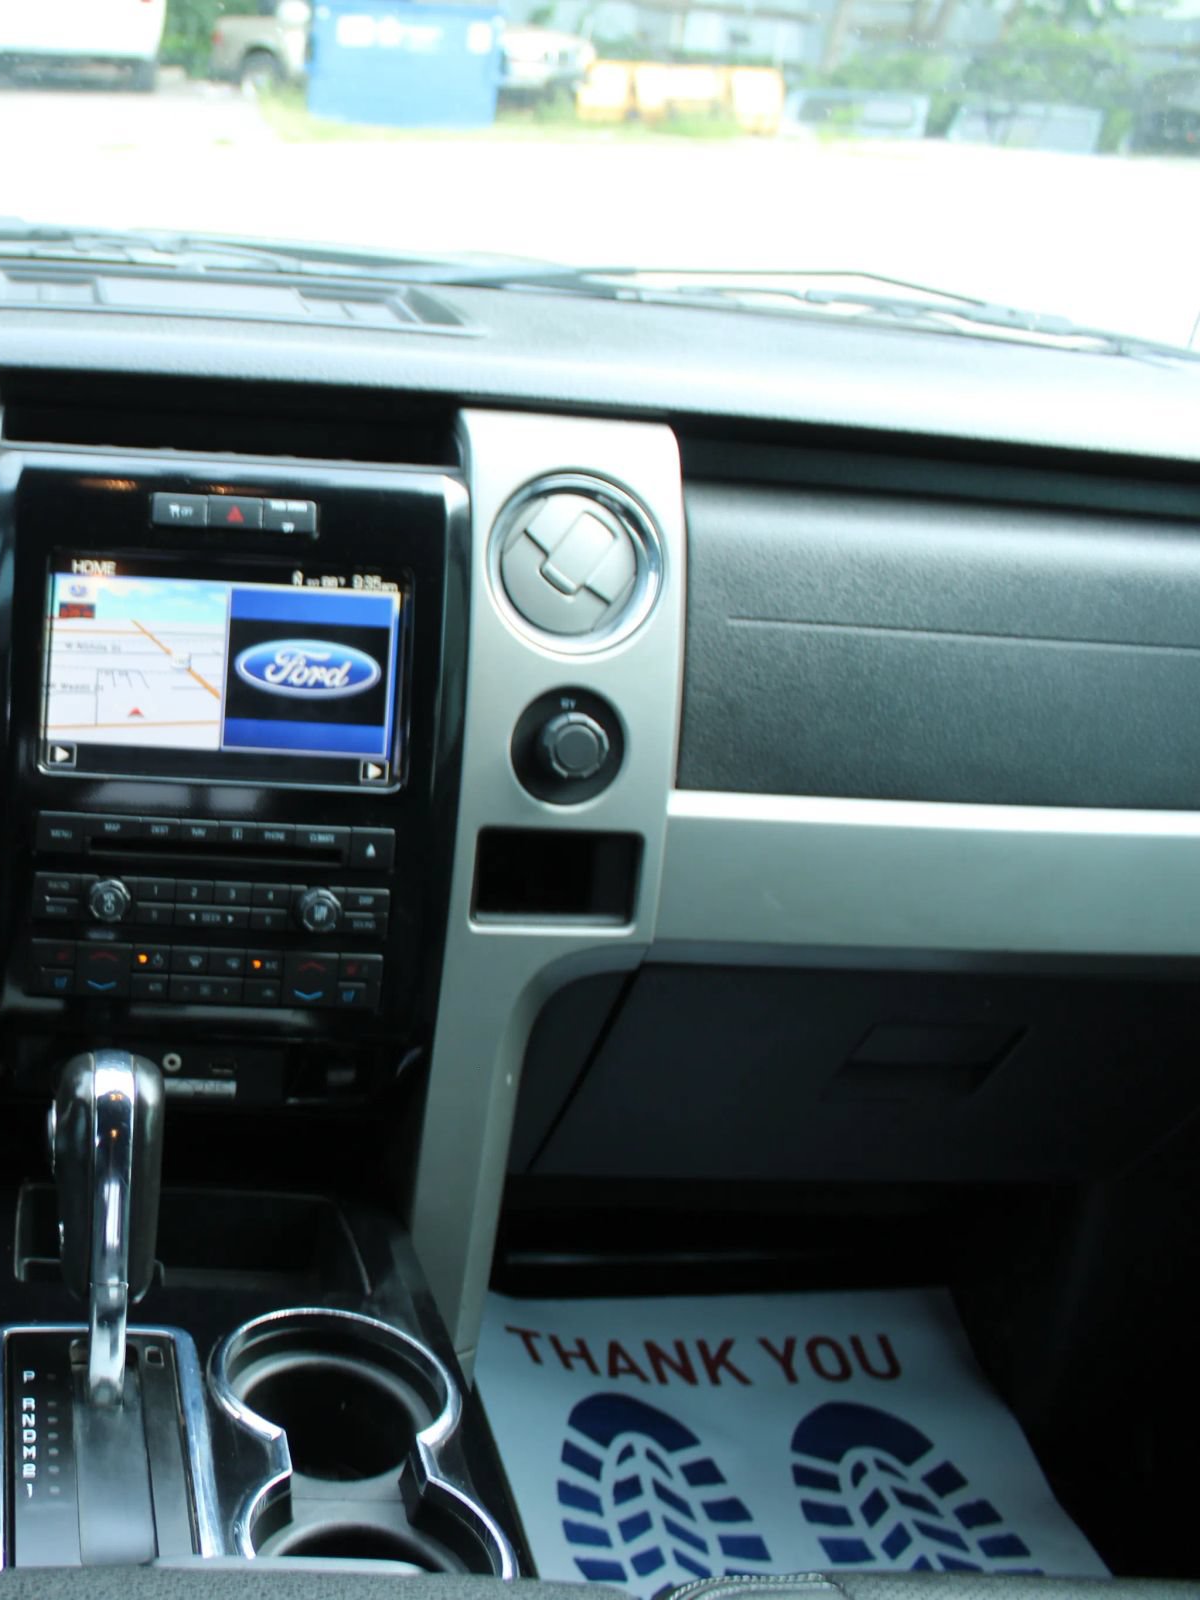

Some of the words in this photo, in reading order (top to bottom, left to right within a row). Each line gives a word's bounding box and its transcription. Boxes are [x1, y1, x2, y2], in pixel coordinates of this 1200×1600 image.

[71, 559, 117, 576] HOME
[264, 648, 352, 687] Ford
[504, 1324, 754, 1387] THANK
[757, 1332, 903, 1384] YOU
[22, 1370, 36, 1384] P
[21, 1397, 36, 1412] R
[21, 1413, 36, 1428] N
[22, 1429, 37, 1444] D
[22, 1445, 37, 1460] M
[26, 1483, 33, 1498] 1
